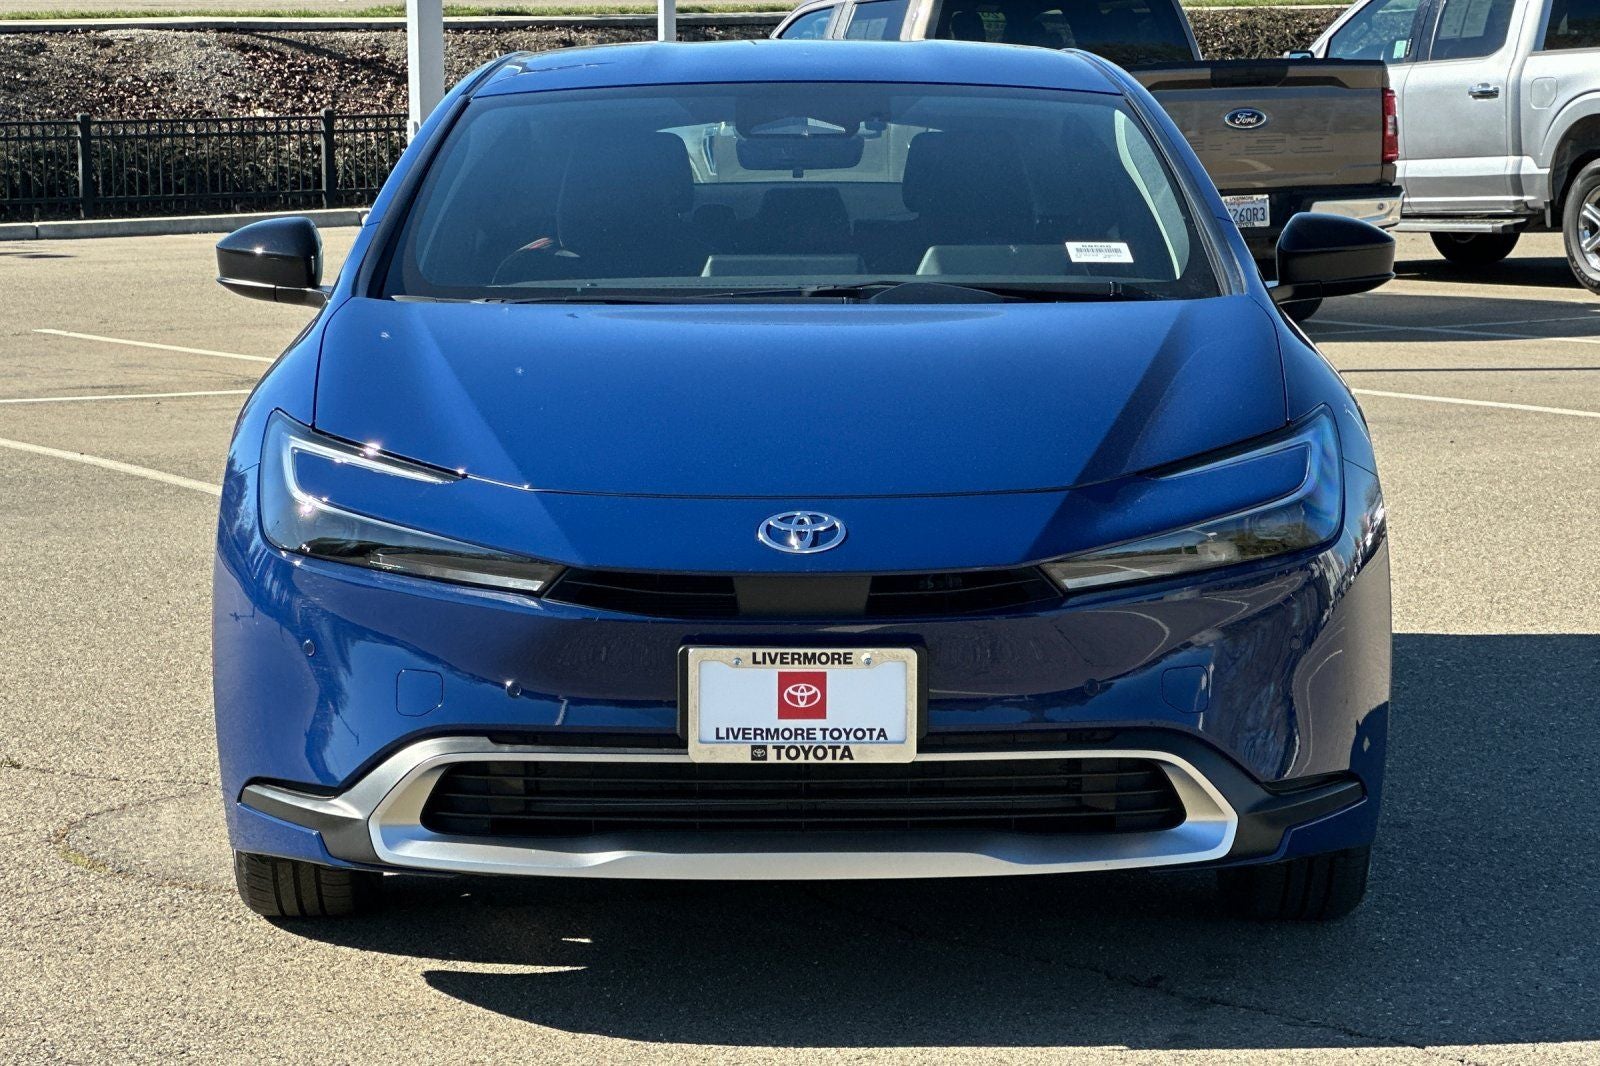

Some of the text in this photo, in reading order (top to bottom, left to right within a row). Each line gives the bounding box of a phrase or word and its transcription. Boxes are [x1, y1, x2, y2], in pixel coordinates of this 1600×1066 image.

[1234, 112, 1258, 124] Ford
[752, 652, 854, 666] LIVERMORE
[715, 727, 888, 741] LIVERMORE TOYOTA
[772, 745, 854, 761] TOYOTA
